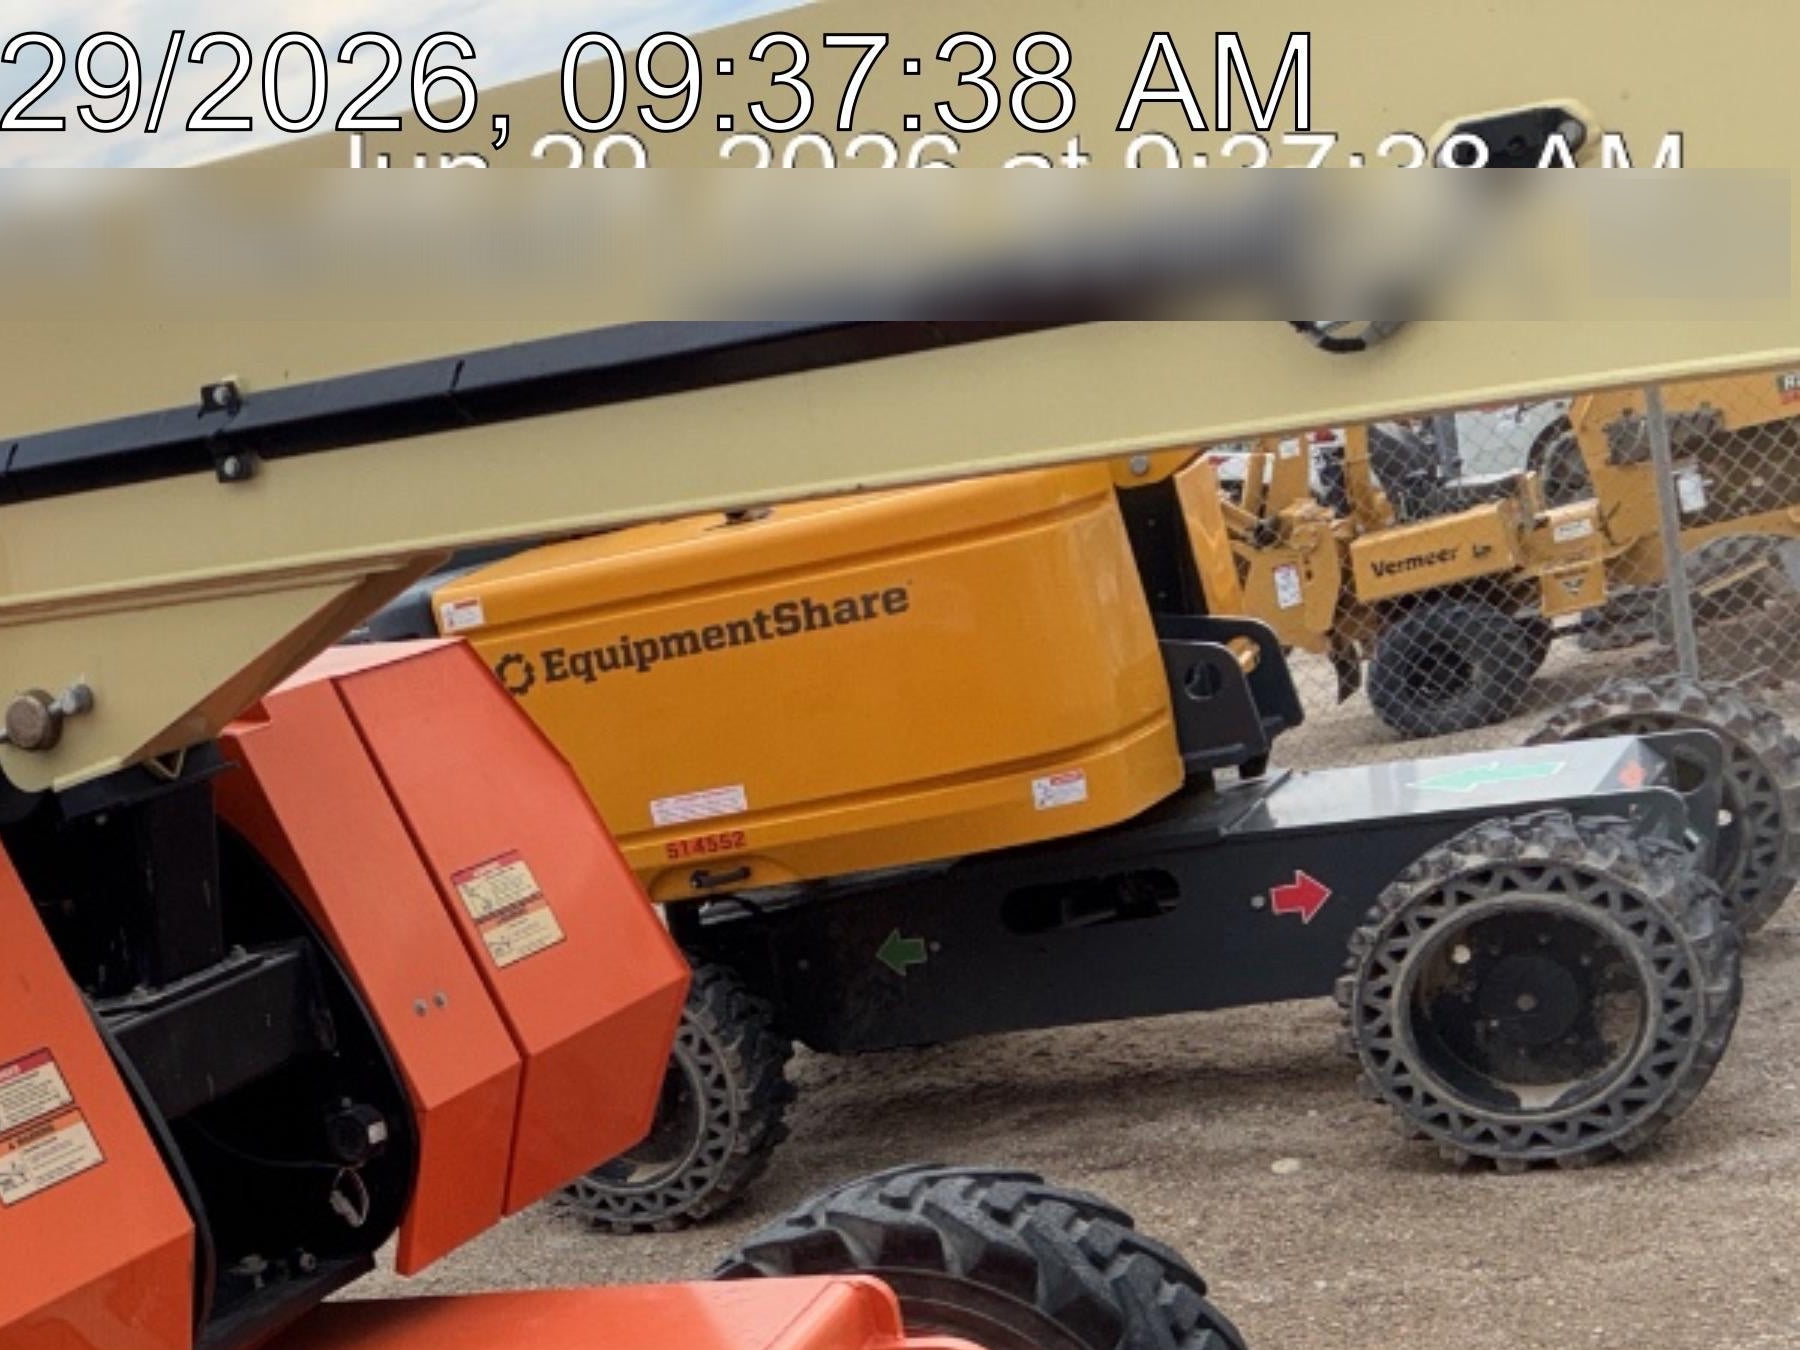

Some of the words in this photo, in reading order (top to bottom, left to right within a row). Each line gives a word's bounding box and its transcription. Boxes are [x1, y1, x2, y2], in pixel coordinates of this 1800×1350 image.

[1369, 546, 1458, 578] Vermeer
[540, 586, 911, 685] EquipmentShare
[665, 830, 747, 860] 514552
